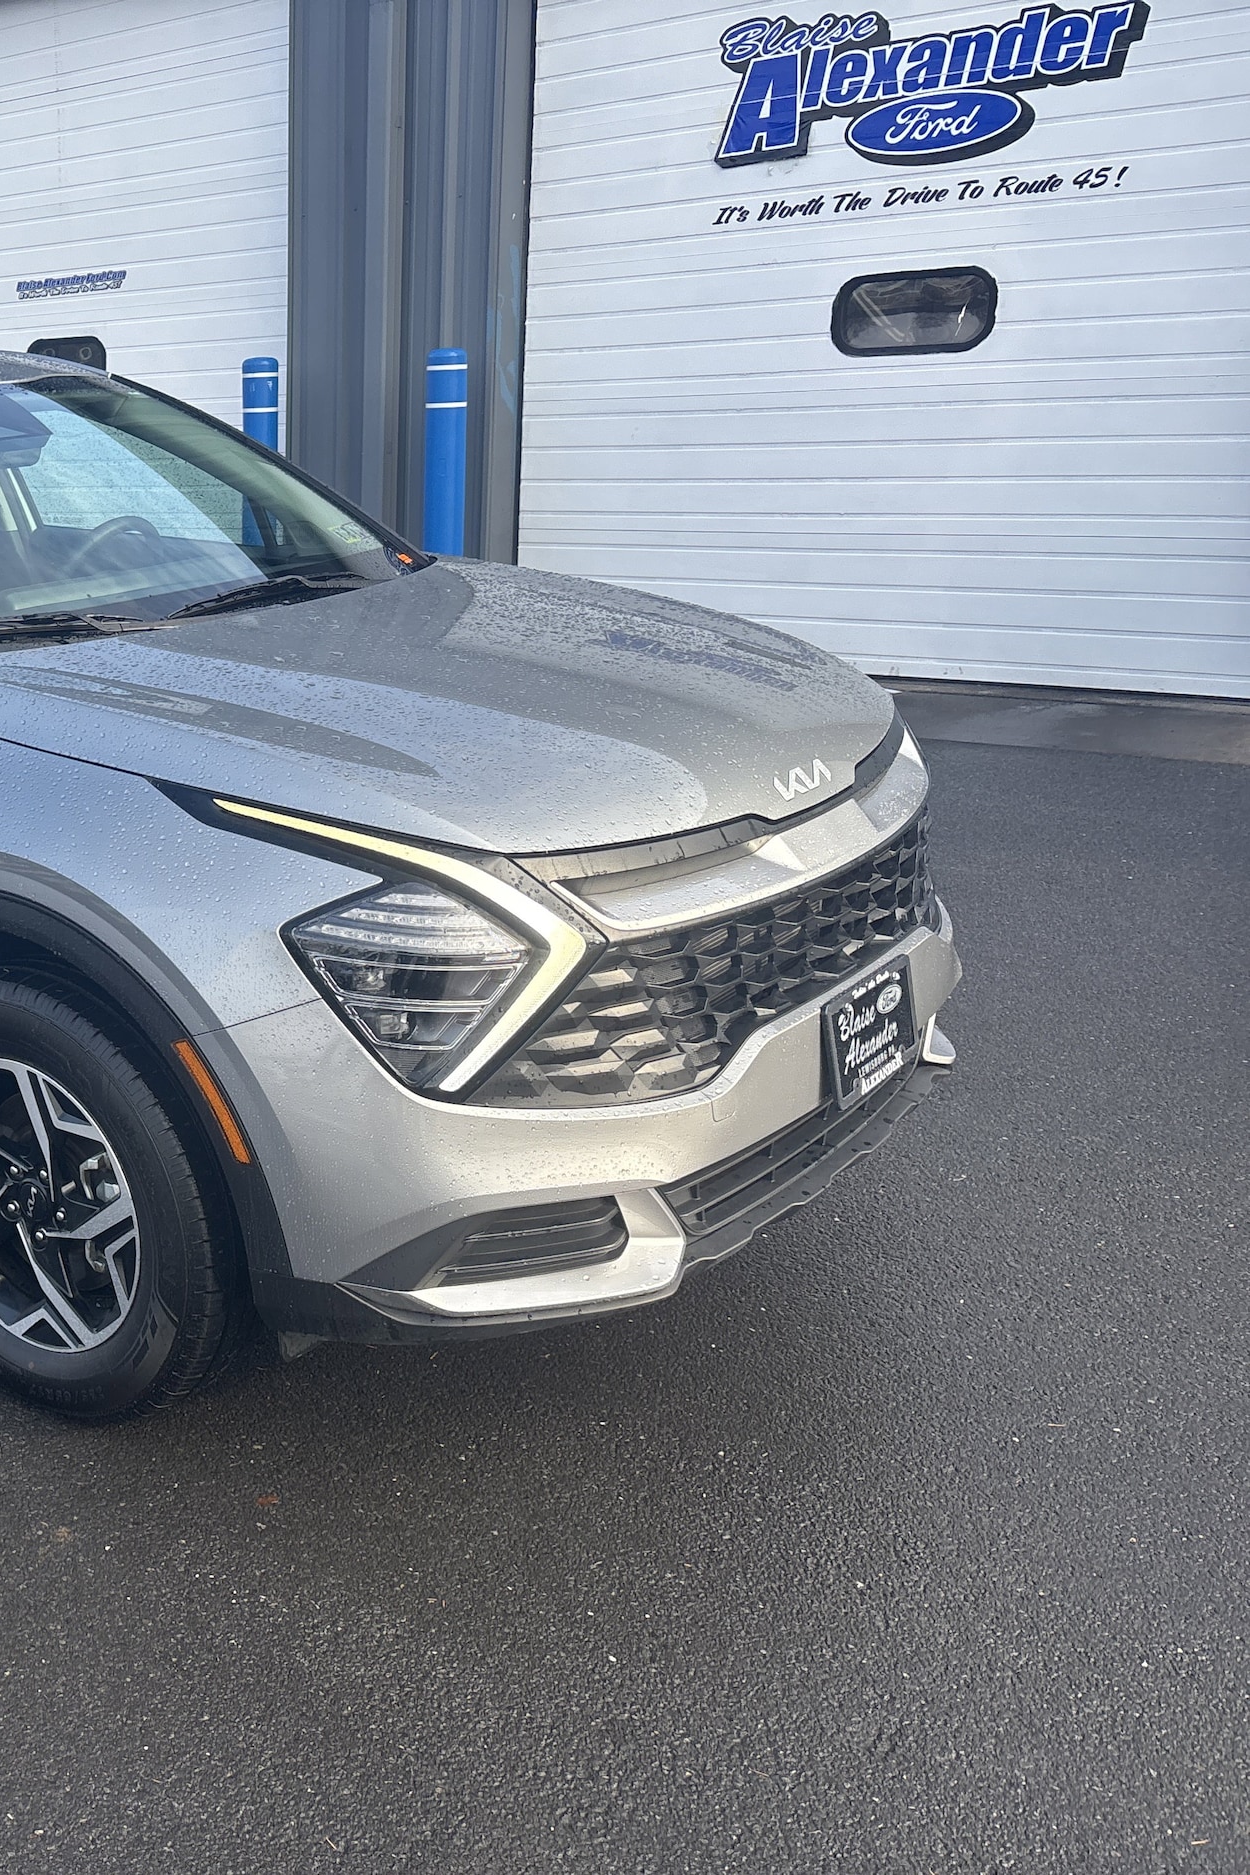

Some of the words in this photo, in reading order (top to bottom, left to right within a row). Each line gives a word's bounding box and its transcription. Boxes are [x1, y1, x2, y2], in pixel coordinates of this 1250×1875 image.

[723, 10, 879, 63] Blaise
[718, 1, 1133, 159] Alexander
[884, 101, 981, 145] Ford
[712, 205, 750, 226] It's
[757, 194, 825, 223] Worth
[833, 192, 873, 214] The
[885, 185, 950, 209] Drive
[958, 179, 986, 201] To
[998, 173, 1065, 198] Route
[773, 759, 832, 801] KIA
[838, 1003, 877, 1042] Blaise
[844, 1018, 899, 1076] Alexander
[861, 1051, 904, 1096] ALEXANDER
